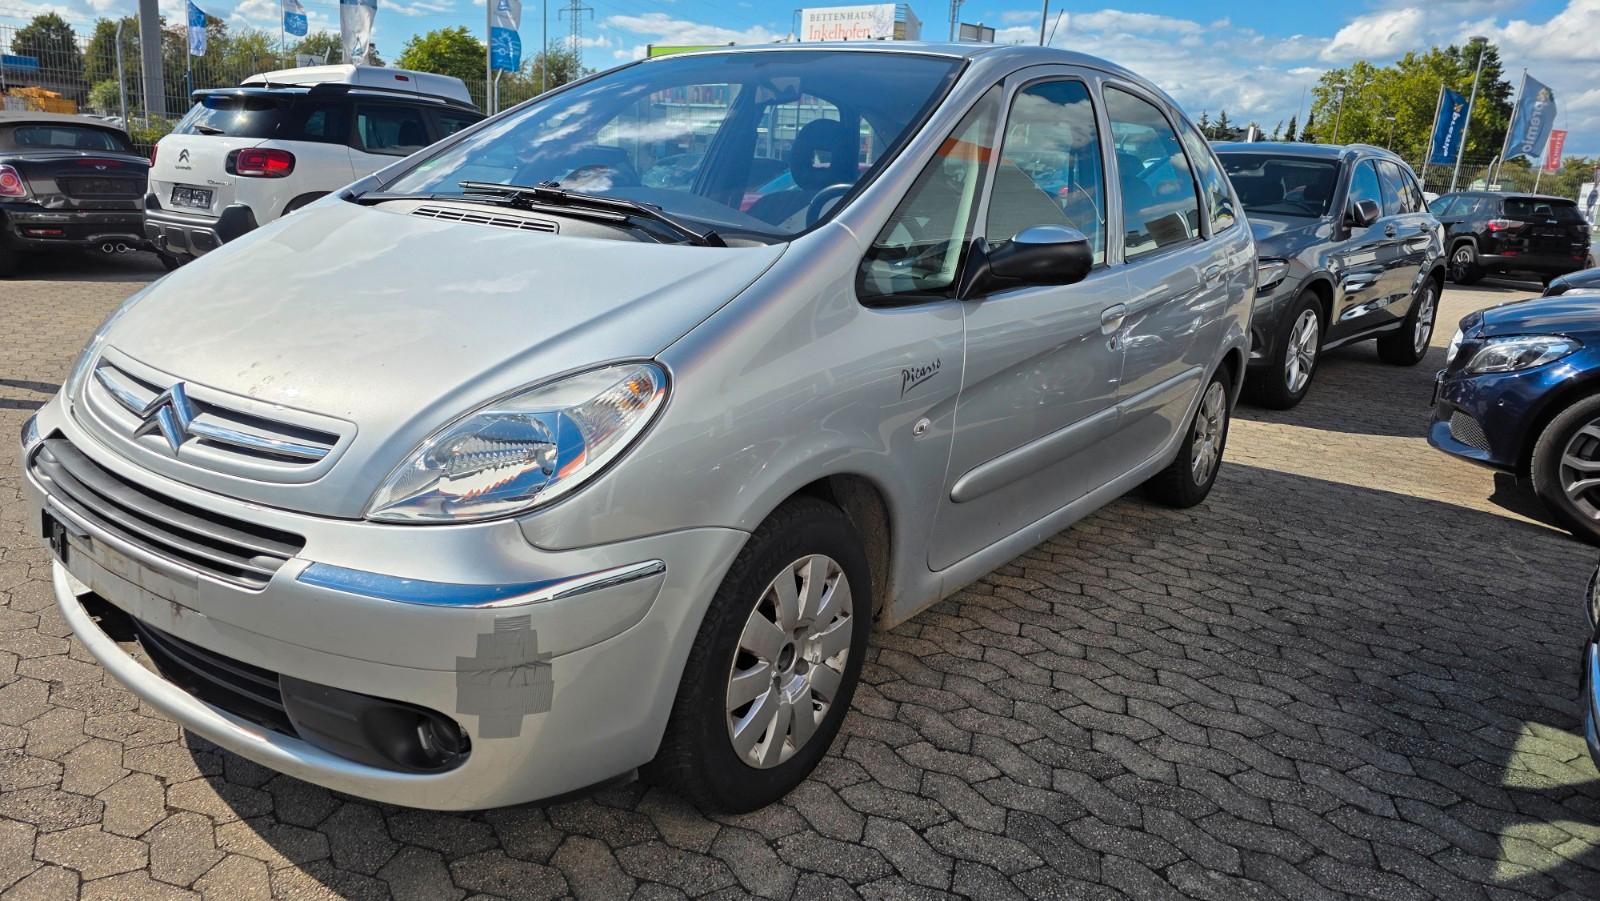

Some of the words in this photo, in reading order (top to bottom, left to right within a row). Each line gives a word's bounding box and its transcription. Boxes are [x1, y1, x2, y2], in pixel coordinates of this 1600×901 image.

[809, 11, 873, 22] BETTENHAUS
[808, 22, 871, 40] Inkelhofen
[900, 357, 941, 400] Picasso
